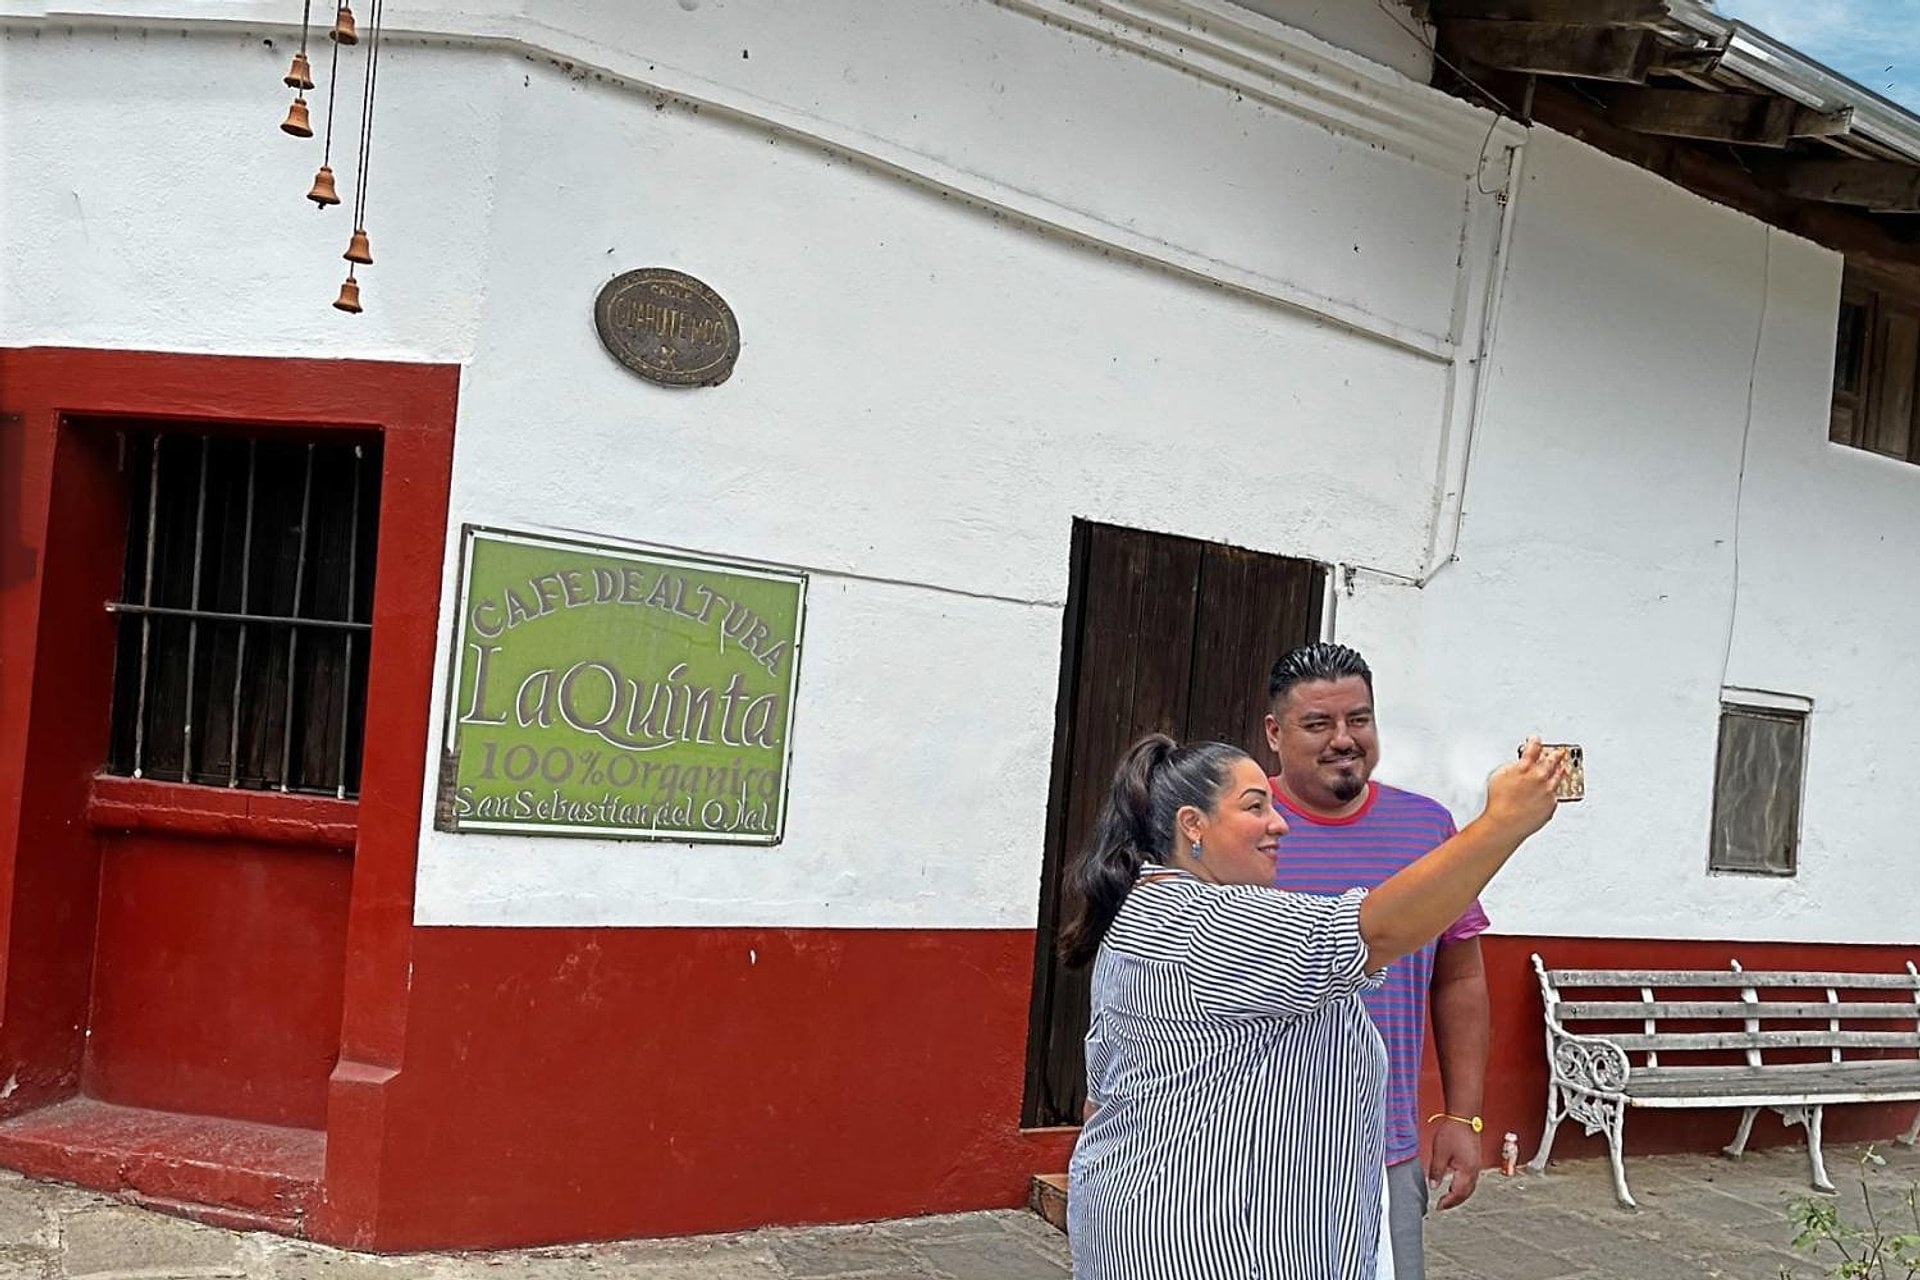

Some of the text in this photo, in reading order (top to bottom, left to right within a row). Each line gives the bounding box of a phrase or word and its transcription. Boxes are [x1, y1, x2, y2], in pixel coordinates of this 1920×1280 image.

[471, 567, 787, 677] CAFE DE ALTURA
[459, 643, 556, 729] La
[479, 740, 604, 786] 100%
[455, 786, 512, 818] San
[655, 797, 693, 828] del
